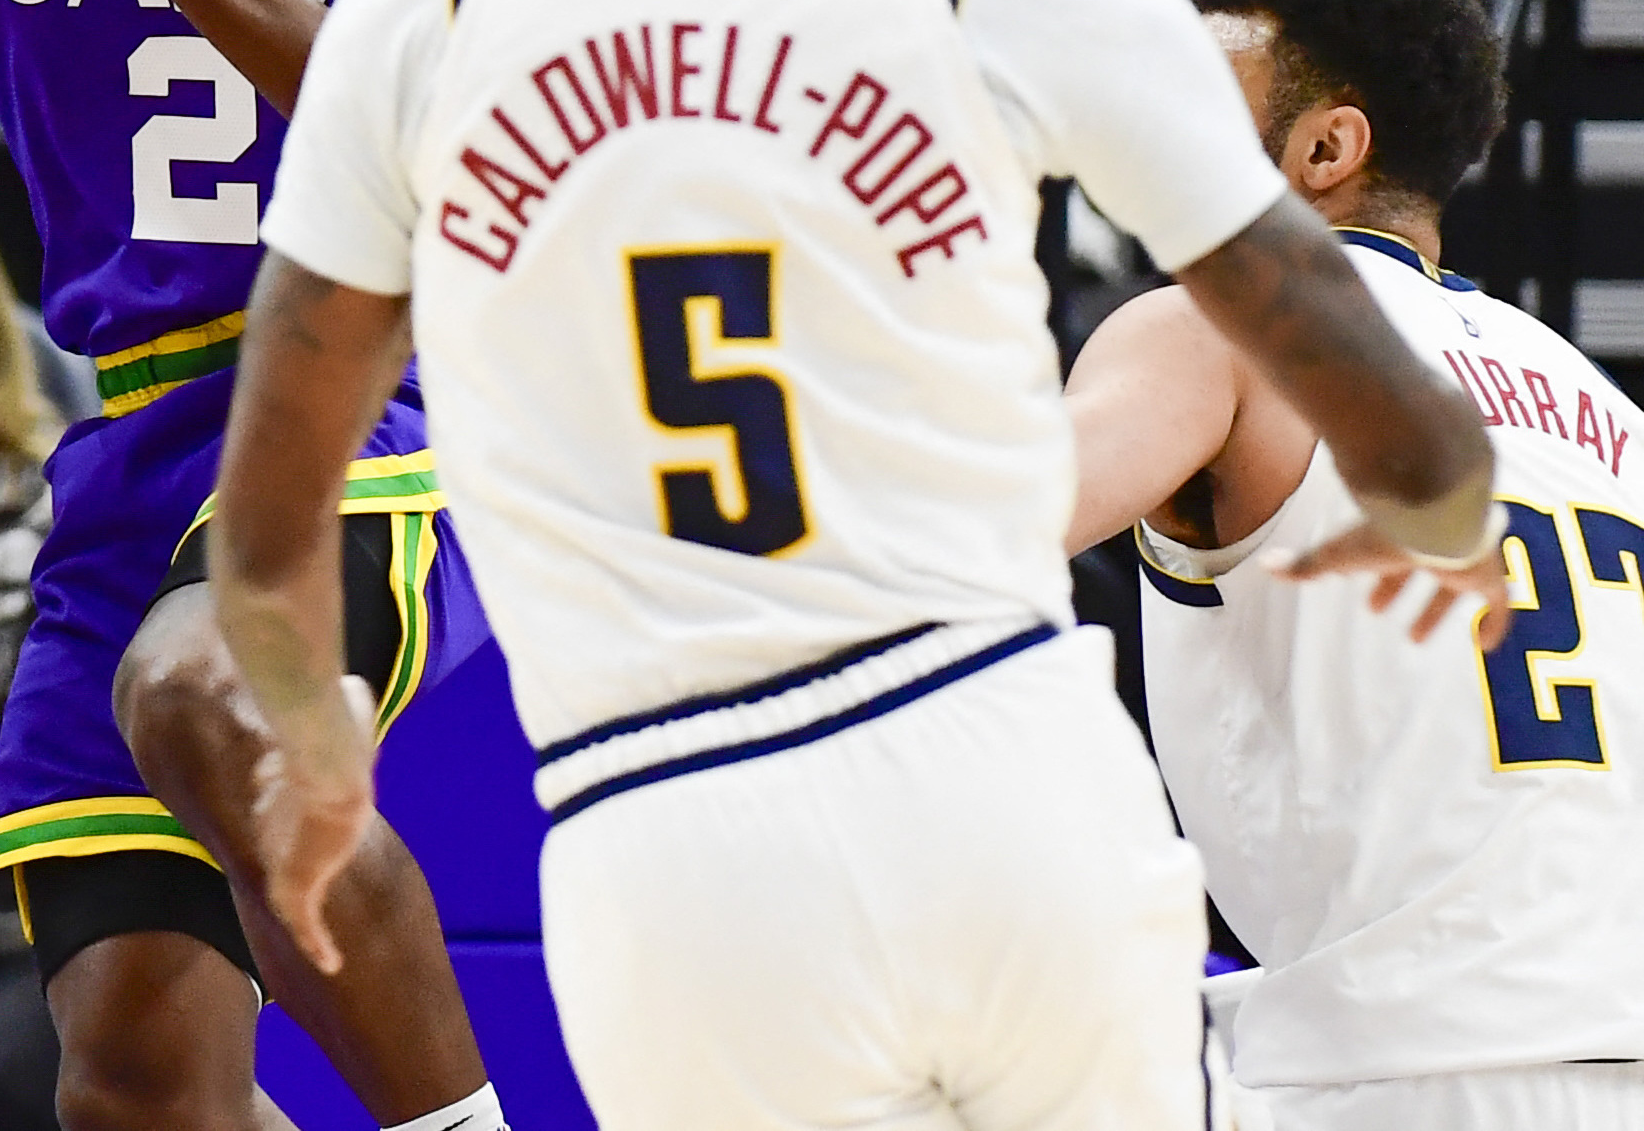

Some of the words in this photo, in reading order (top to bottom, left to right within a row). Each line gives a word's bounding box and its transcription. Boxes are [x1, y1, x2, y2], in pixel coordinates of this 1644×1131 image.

[126, 35, 259, 245] 2
[438, 21, 989, 280] CALDWELL-POPE
[621, 240, 817, 560] 5
[1442, 348, 1630, 479] URRAY
